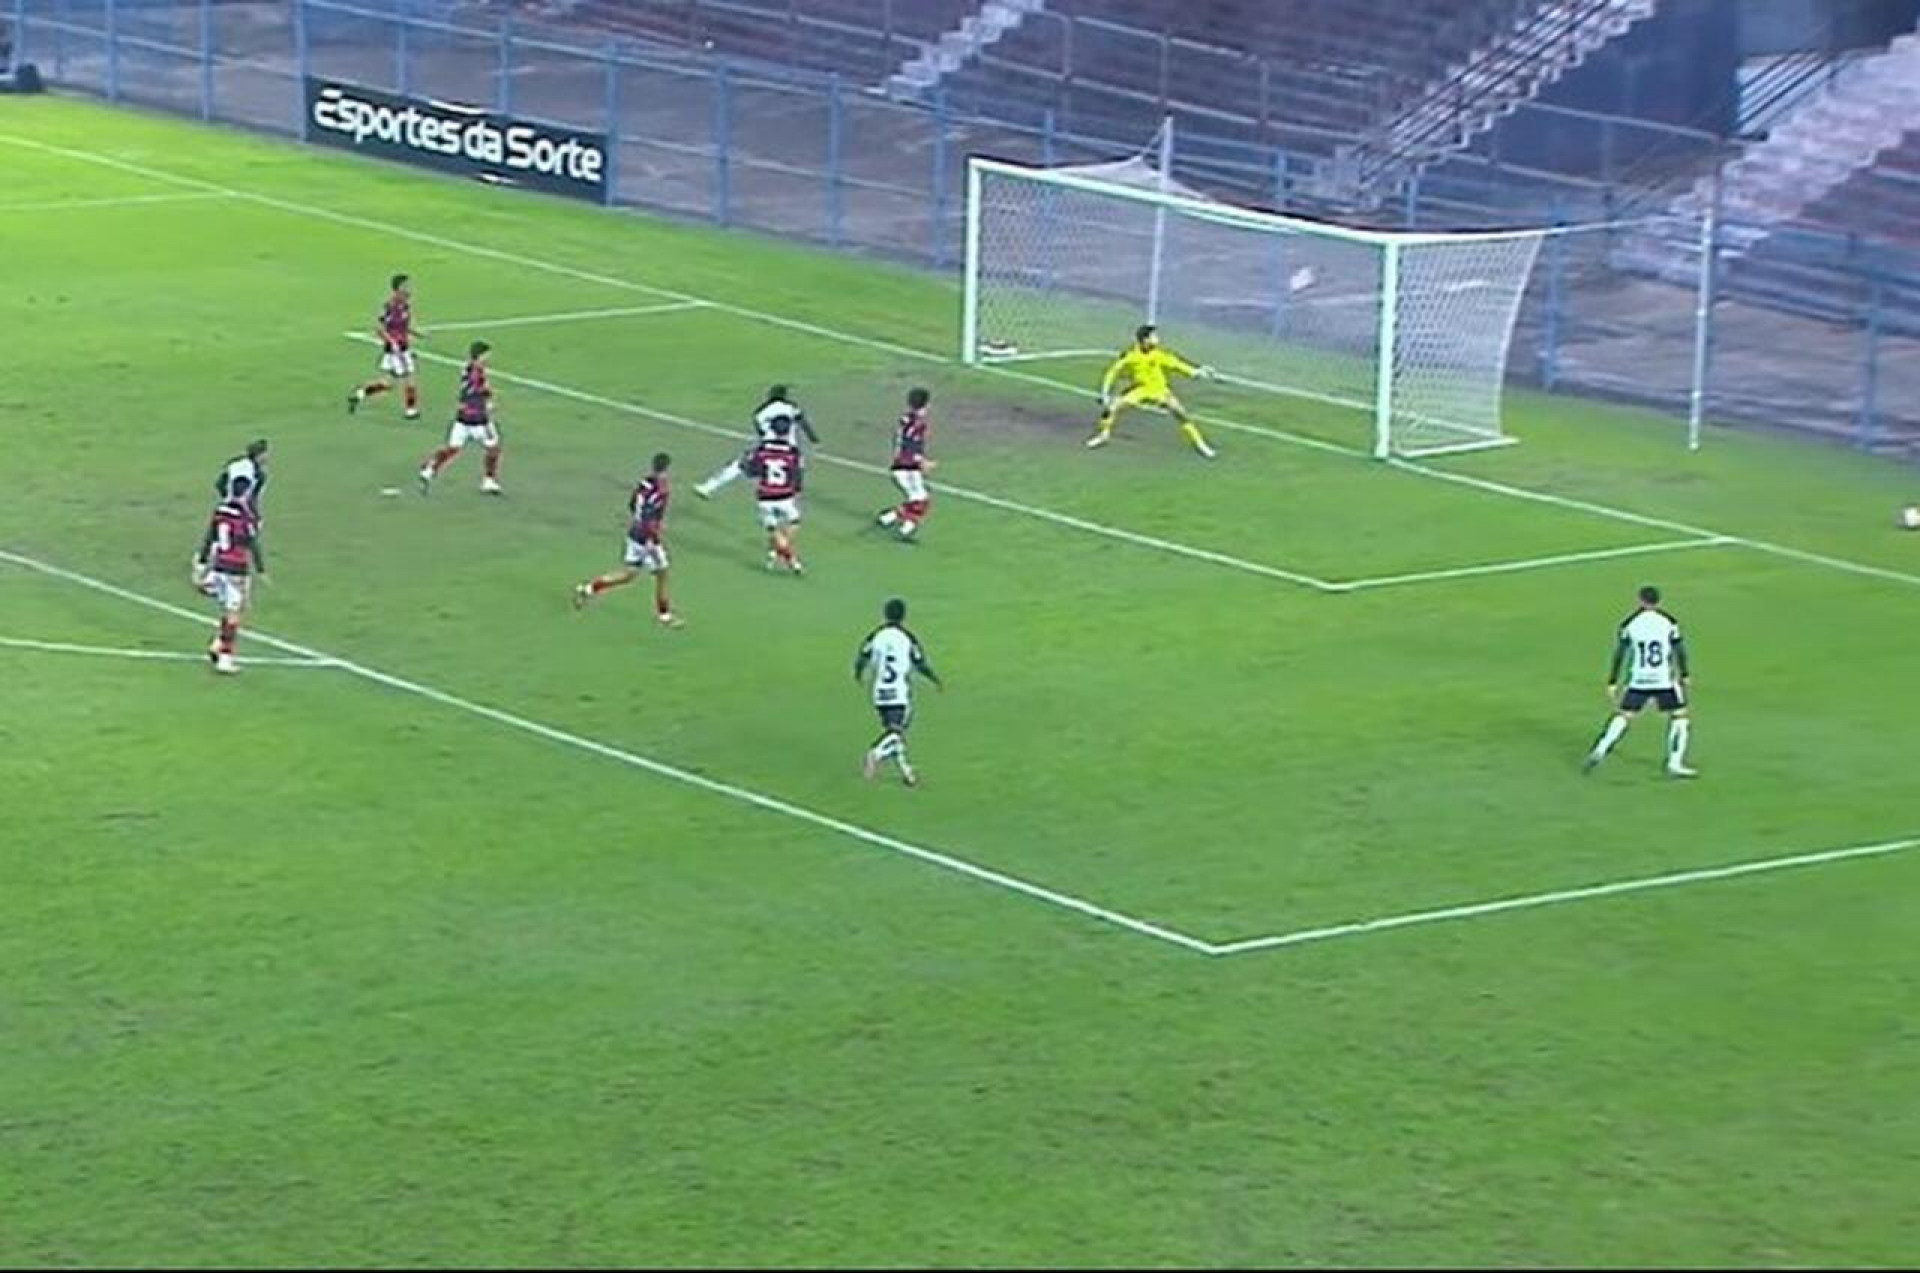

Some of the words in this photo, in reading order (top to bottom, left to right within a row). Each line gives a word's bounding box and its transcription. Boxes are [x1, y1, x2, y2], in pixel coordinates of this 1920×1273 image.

[313, 87, 461, 155] Esportes
[463, 121, 505, 164] da
[506, 126, 602, 182] Sorte
[1637, 639, 1663, 668] 18
